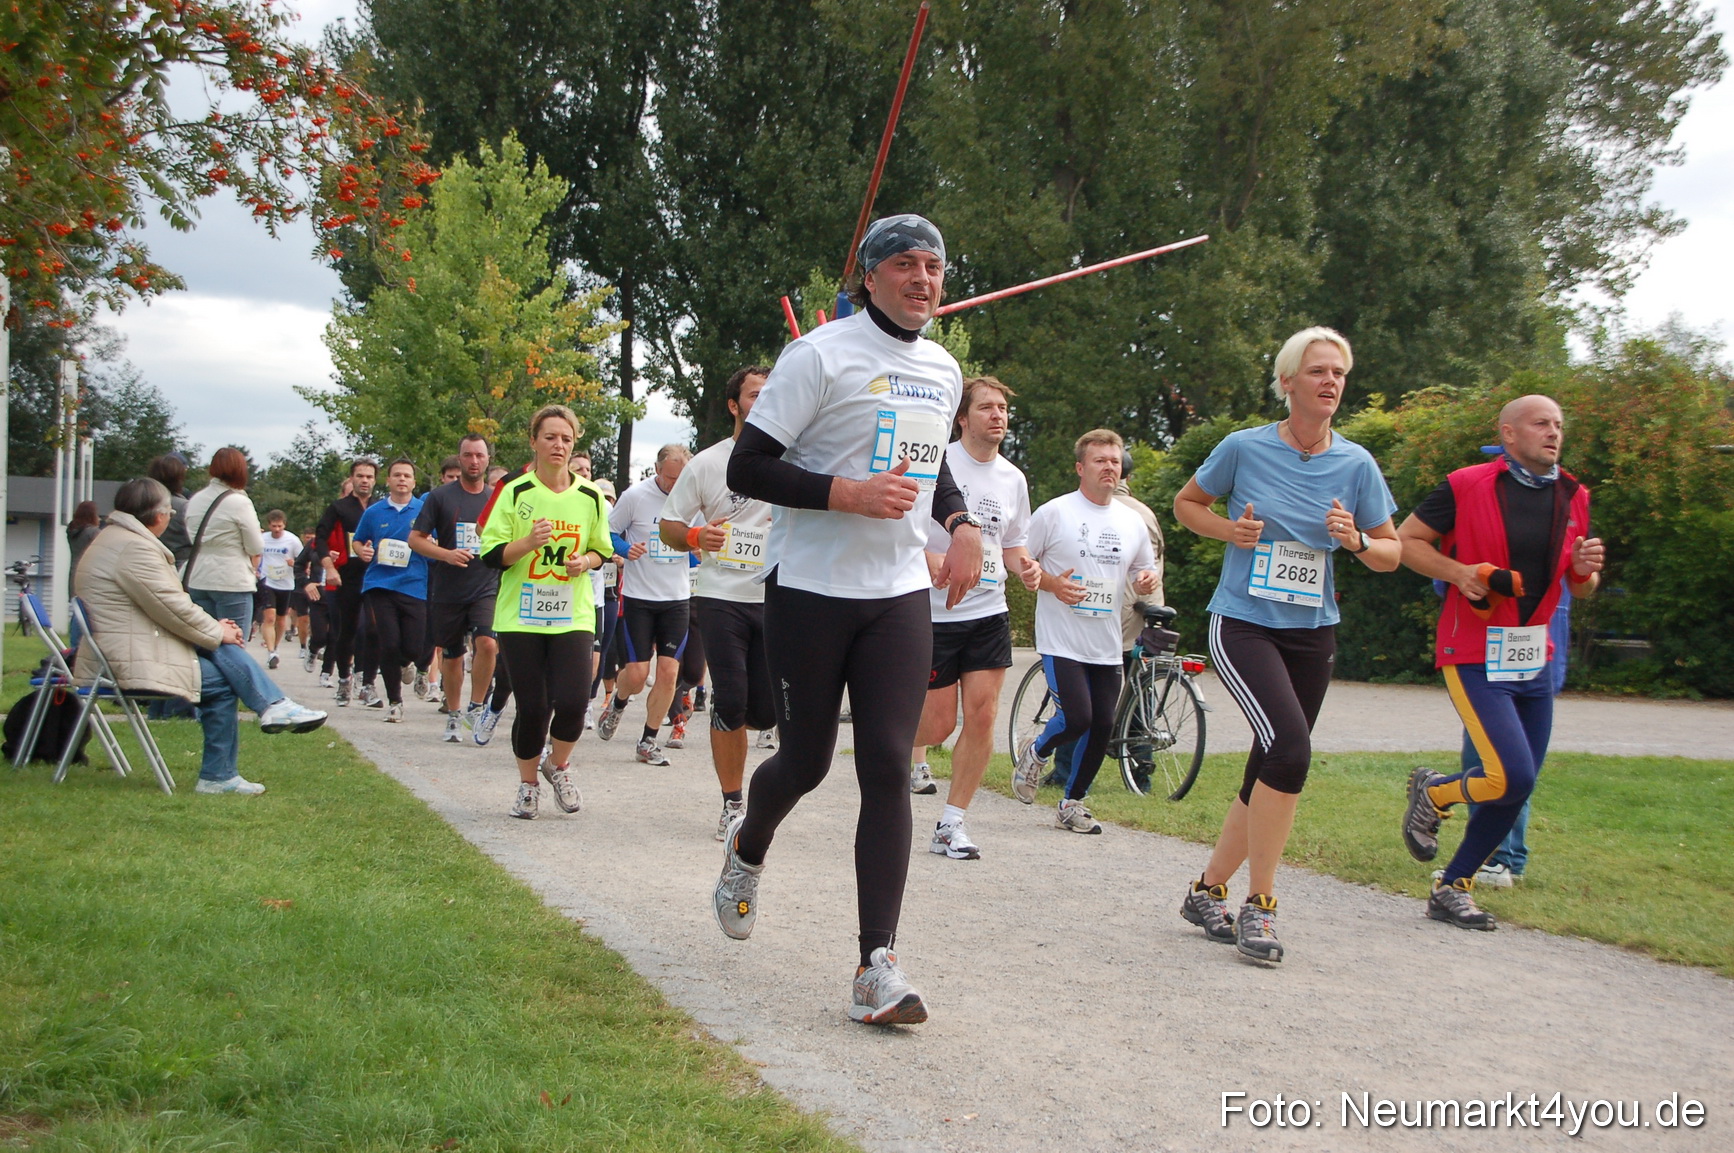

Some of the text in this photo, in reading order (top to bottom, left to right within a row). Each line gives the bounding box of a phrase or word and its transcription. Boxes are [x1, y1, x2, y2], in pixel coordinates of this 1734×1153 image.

[897, 441, 939, 464] 3520
[532, 519, 581, 532] ller
[731, 527, 764, 540] Christian
[388, 549, 405, 559] 839
[541, 545, 567, 566] M
[734, 542, 761, 557] 370
[1278, 544, 1315, 562] Theresia
[983, 560, 996, 574] 95
[1275, 563, 1318, 585] 2682
[603, 571, 614, 580] 75
[536, 588, 559, 597] Monika
[1084, 591, 1113, 605] 2715
[536, 600, 568, 612] 2647
[1506, 645, 1540, 662] 2681
